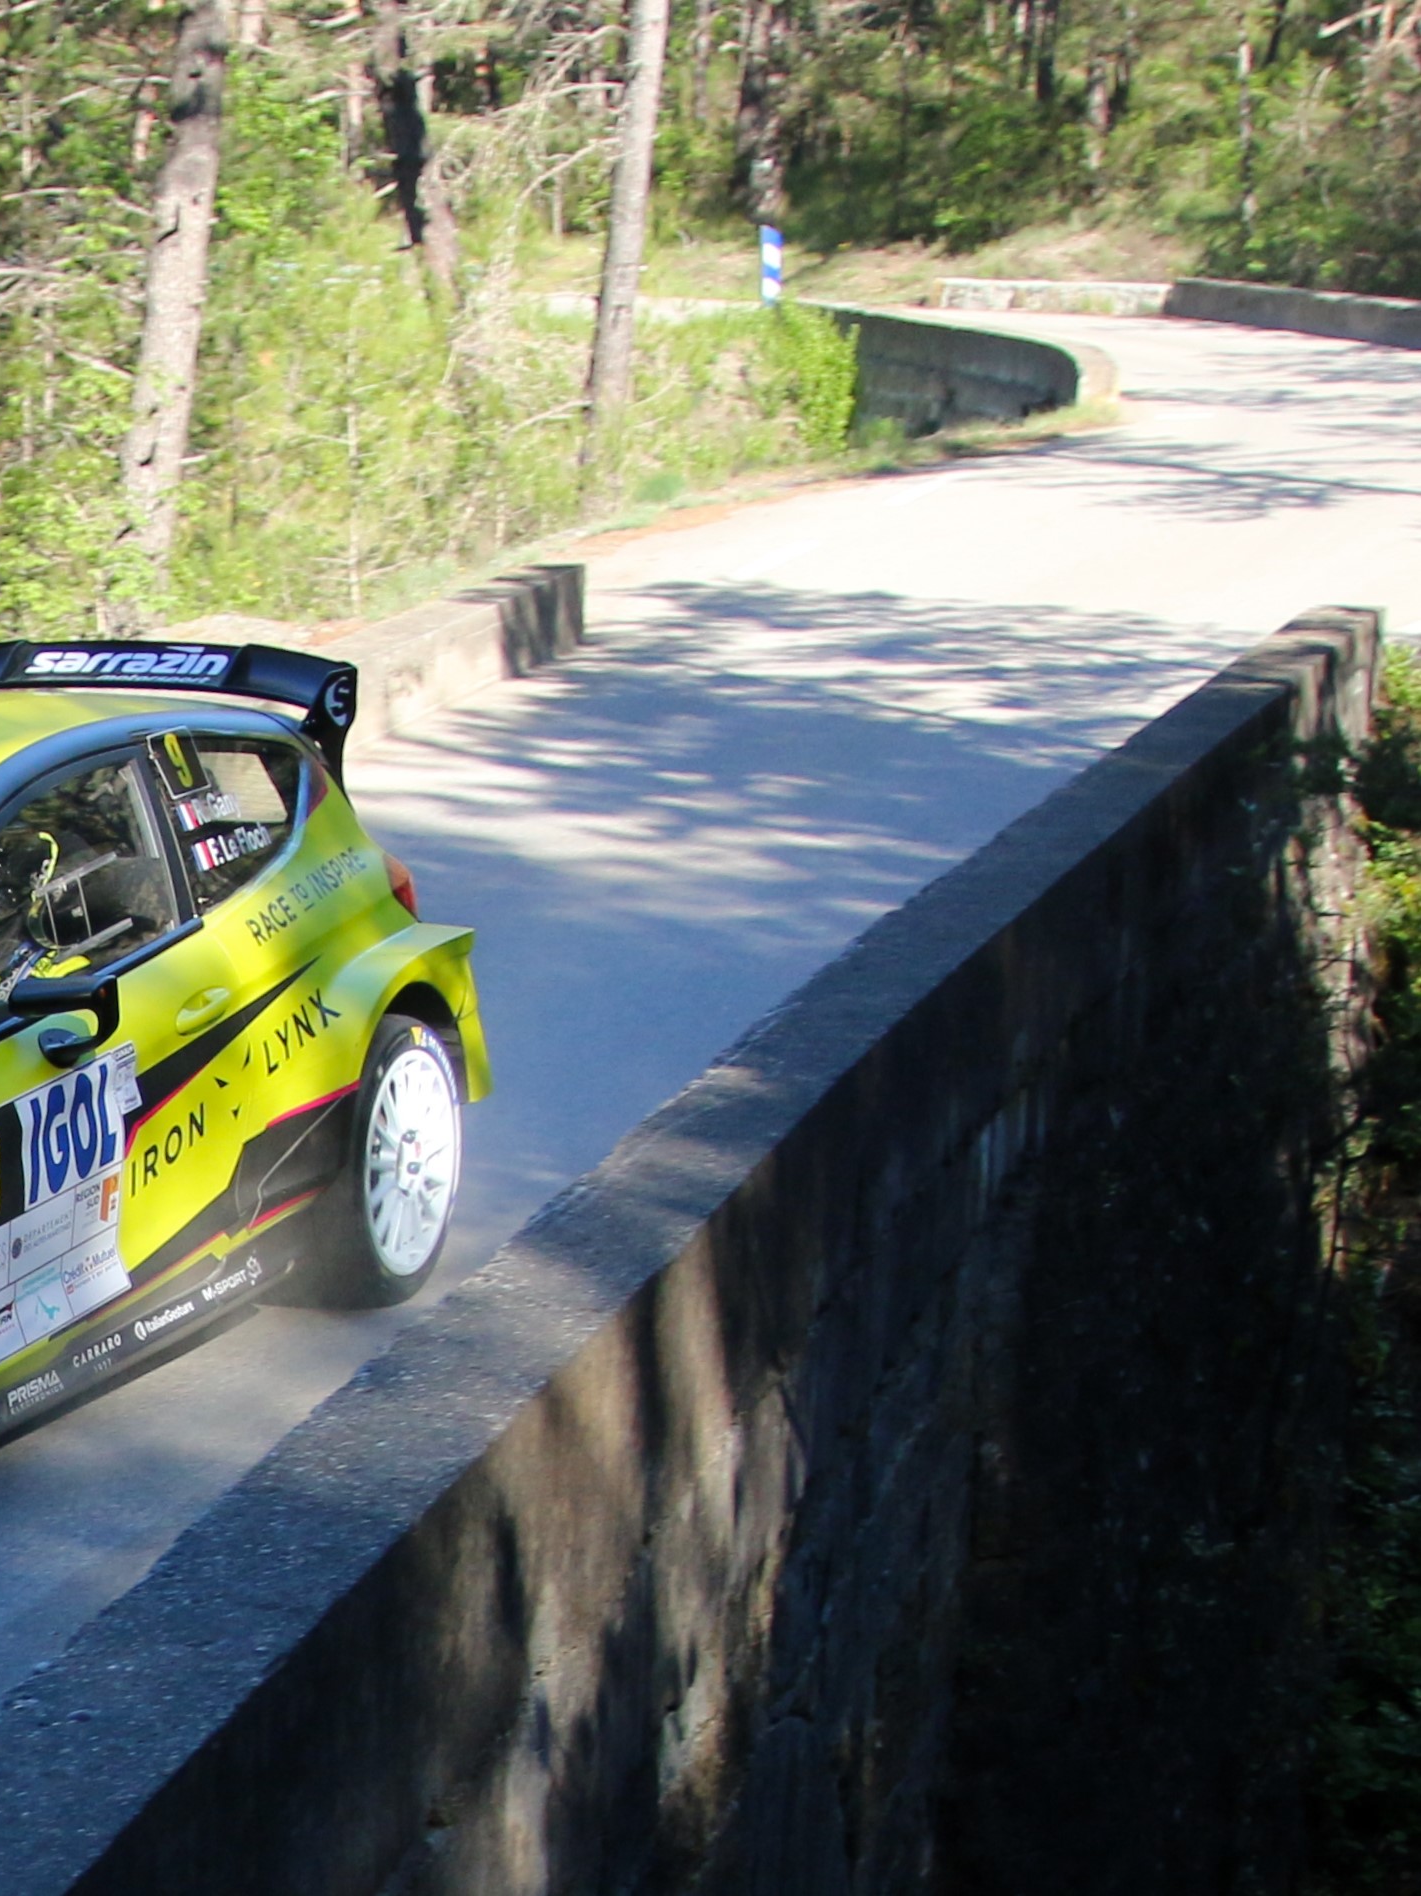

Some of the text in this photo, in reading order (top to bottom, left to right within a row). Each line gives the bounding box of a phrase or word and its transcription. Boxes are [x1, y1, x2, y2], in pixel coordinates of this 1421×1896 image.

[24, 646, 229, 676] sarrazin
[163, 732, 194, 788] 9
[207, 820, 273, 866] F. Le Floch
[244, 846, 368, 947] RACE TO INSPIRE
[130, 1101, 205, 1199] IRON
[263, 987, 342, 1078] LYNX
[28, 1062, 119, 1207] IGOL
[201, 1268, 248, 1302] M-SPORT
[72, 1332, 122, 1368] CARRARO
[7, 1369, 61, 1408] PRISMA
[10, 1383, 65, 1416] ELECTRONICS
